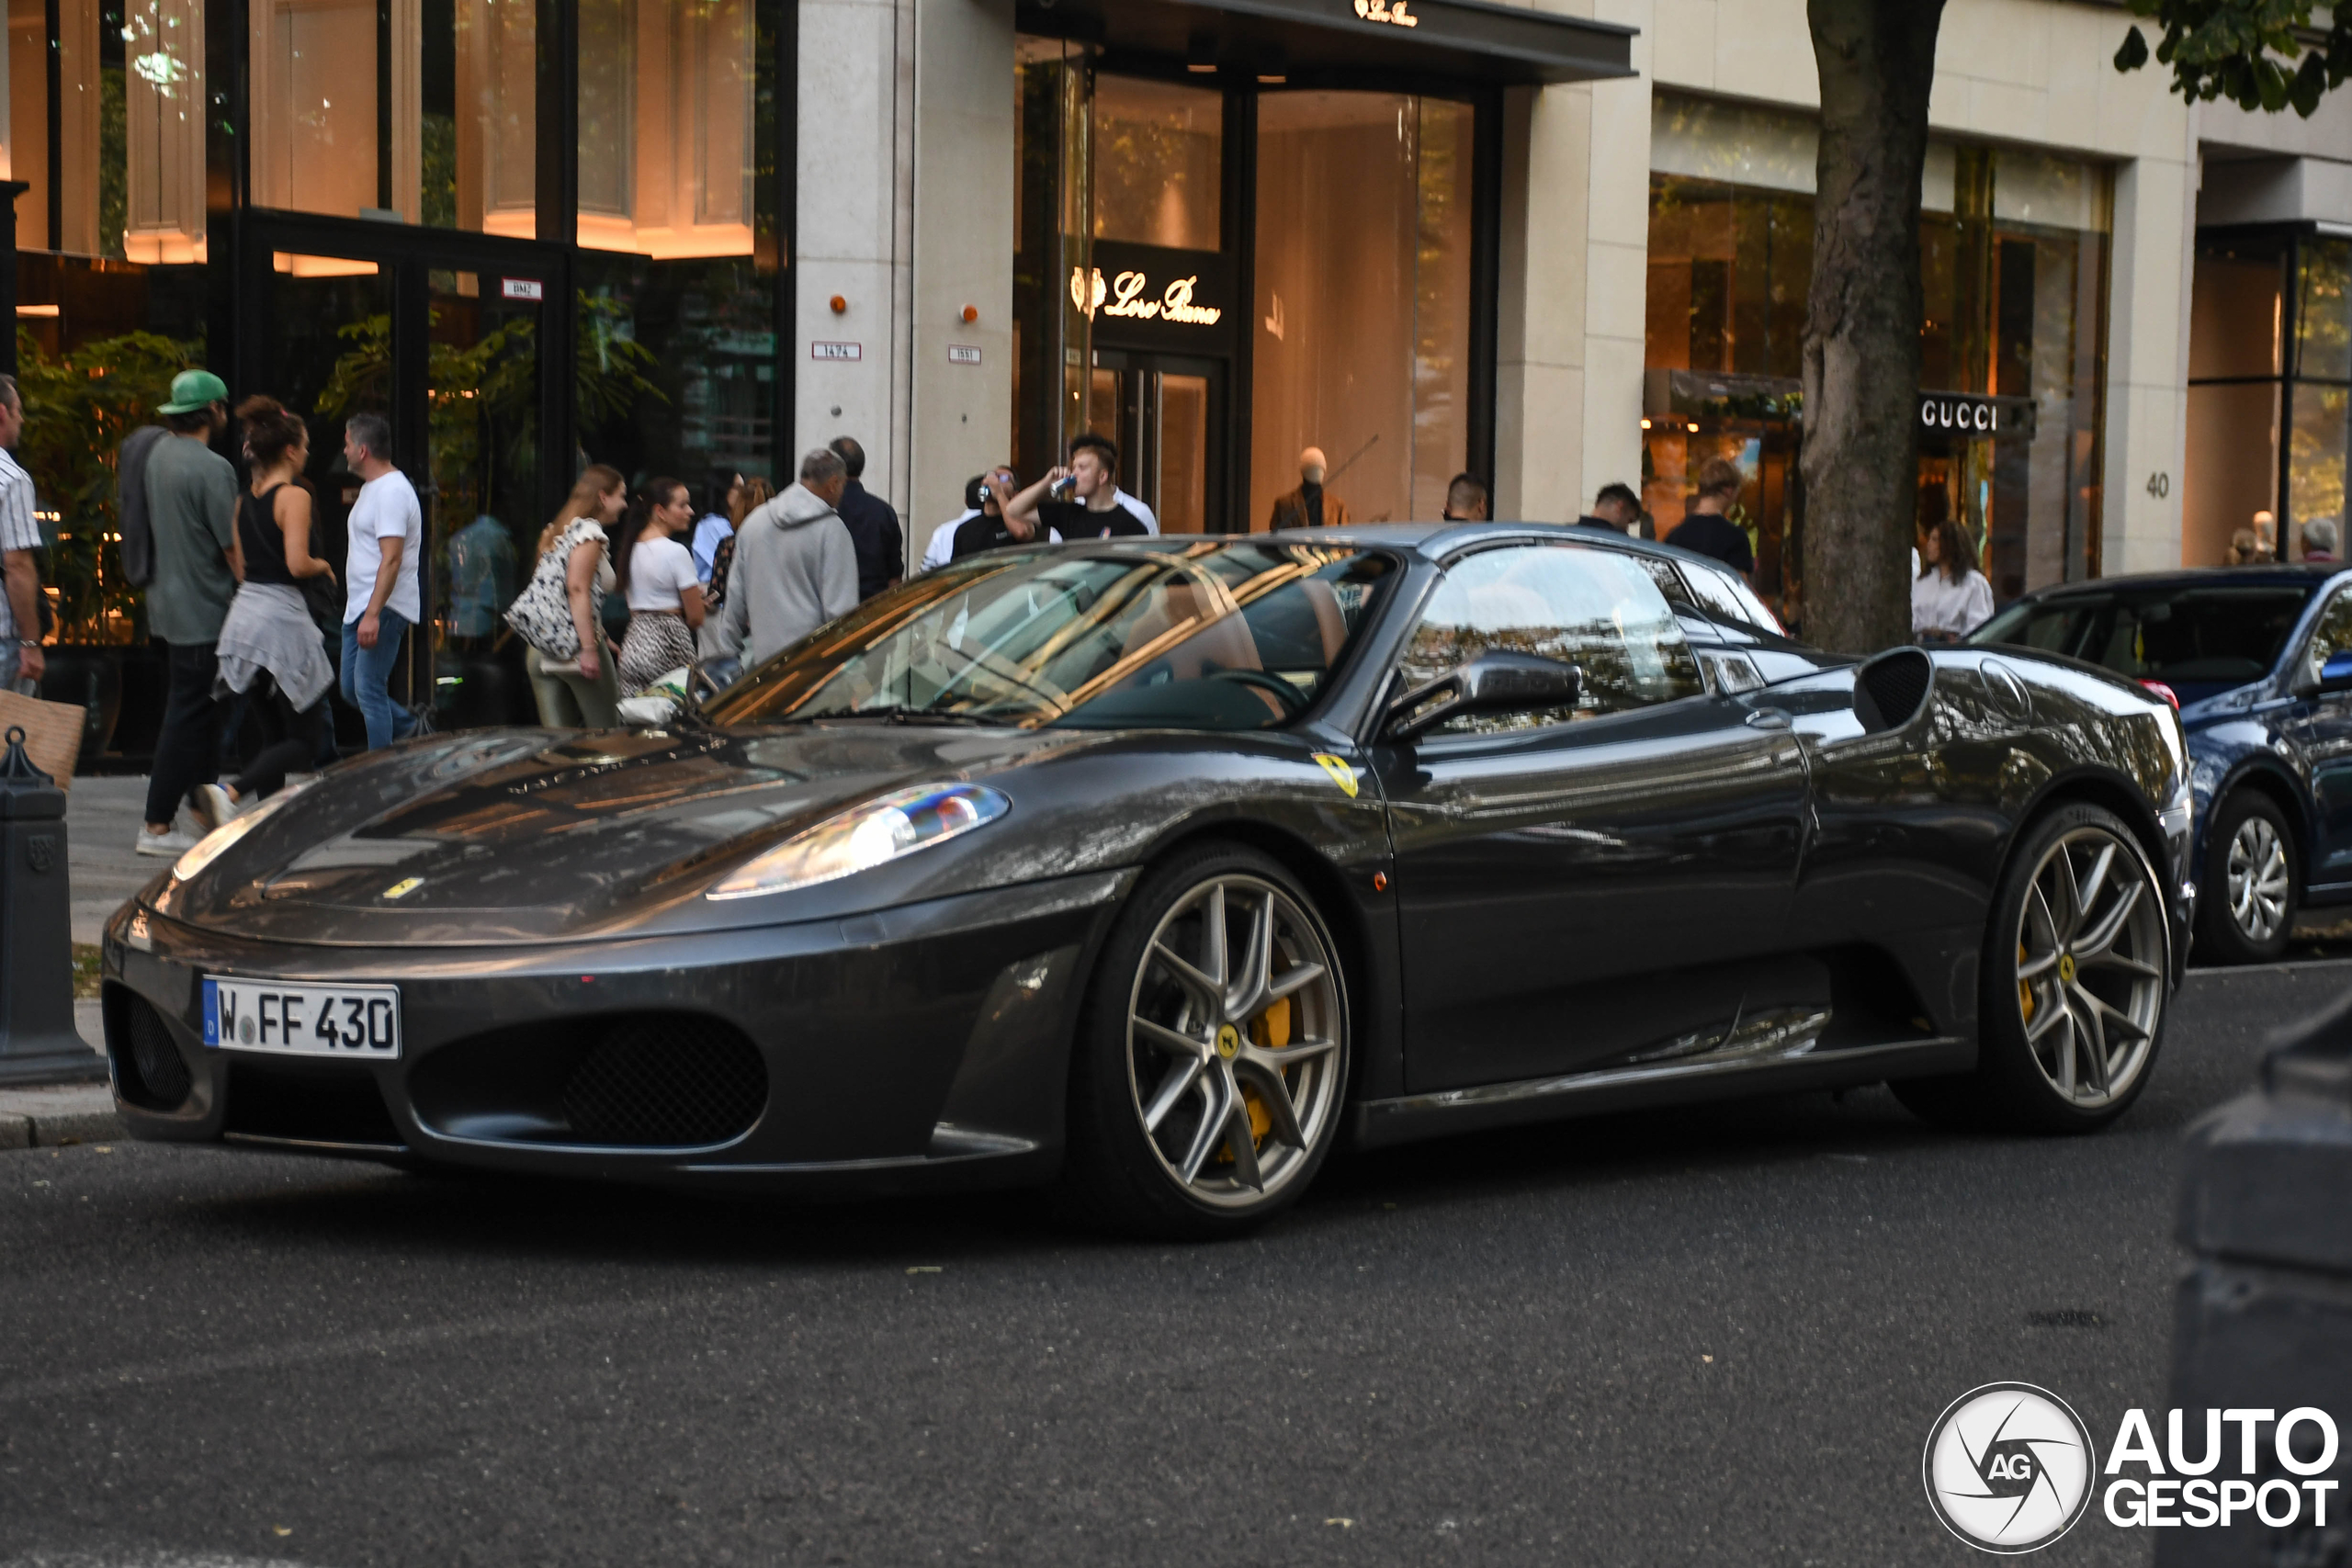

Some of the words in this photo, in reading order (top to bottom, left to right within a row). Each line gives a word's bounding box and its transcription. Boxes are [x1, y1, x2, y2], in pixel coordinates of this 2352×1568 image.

[1103, 271, 1161, 319] Loro
[1160, 275, 1221, 325] Piana
[824, 344, 848, 358] 1474
[1922, 400, 1997, 431] GUCCI
[2146, 471, 2169, 499] 40
[219, 989, 236, 1041] W
[259, 992, 304, 1045] FF
[315, 996, 393, 1049] 430
